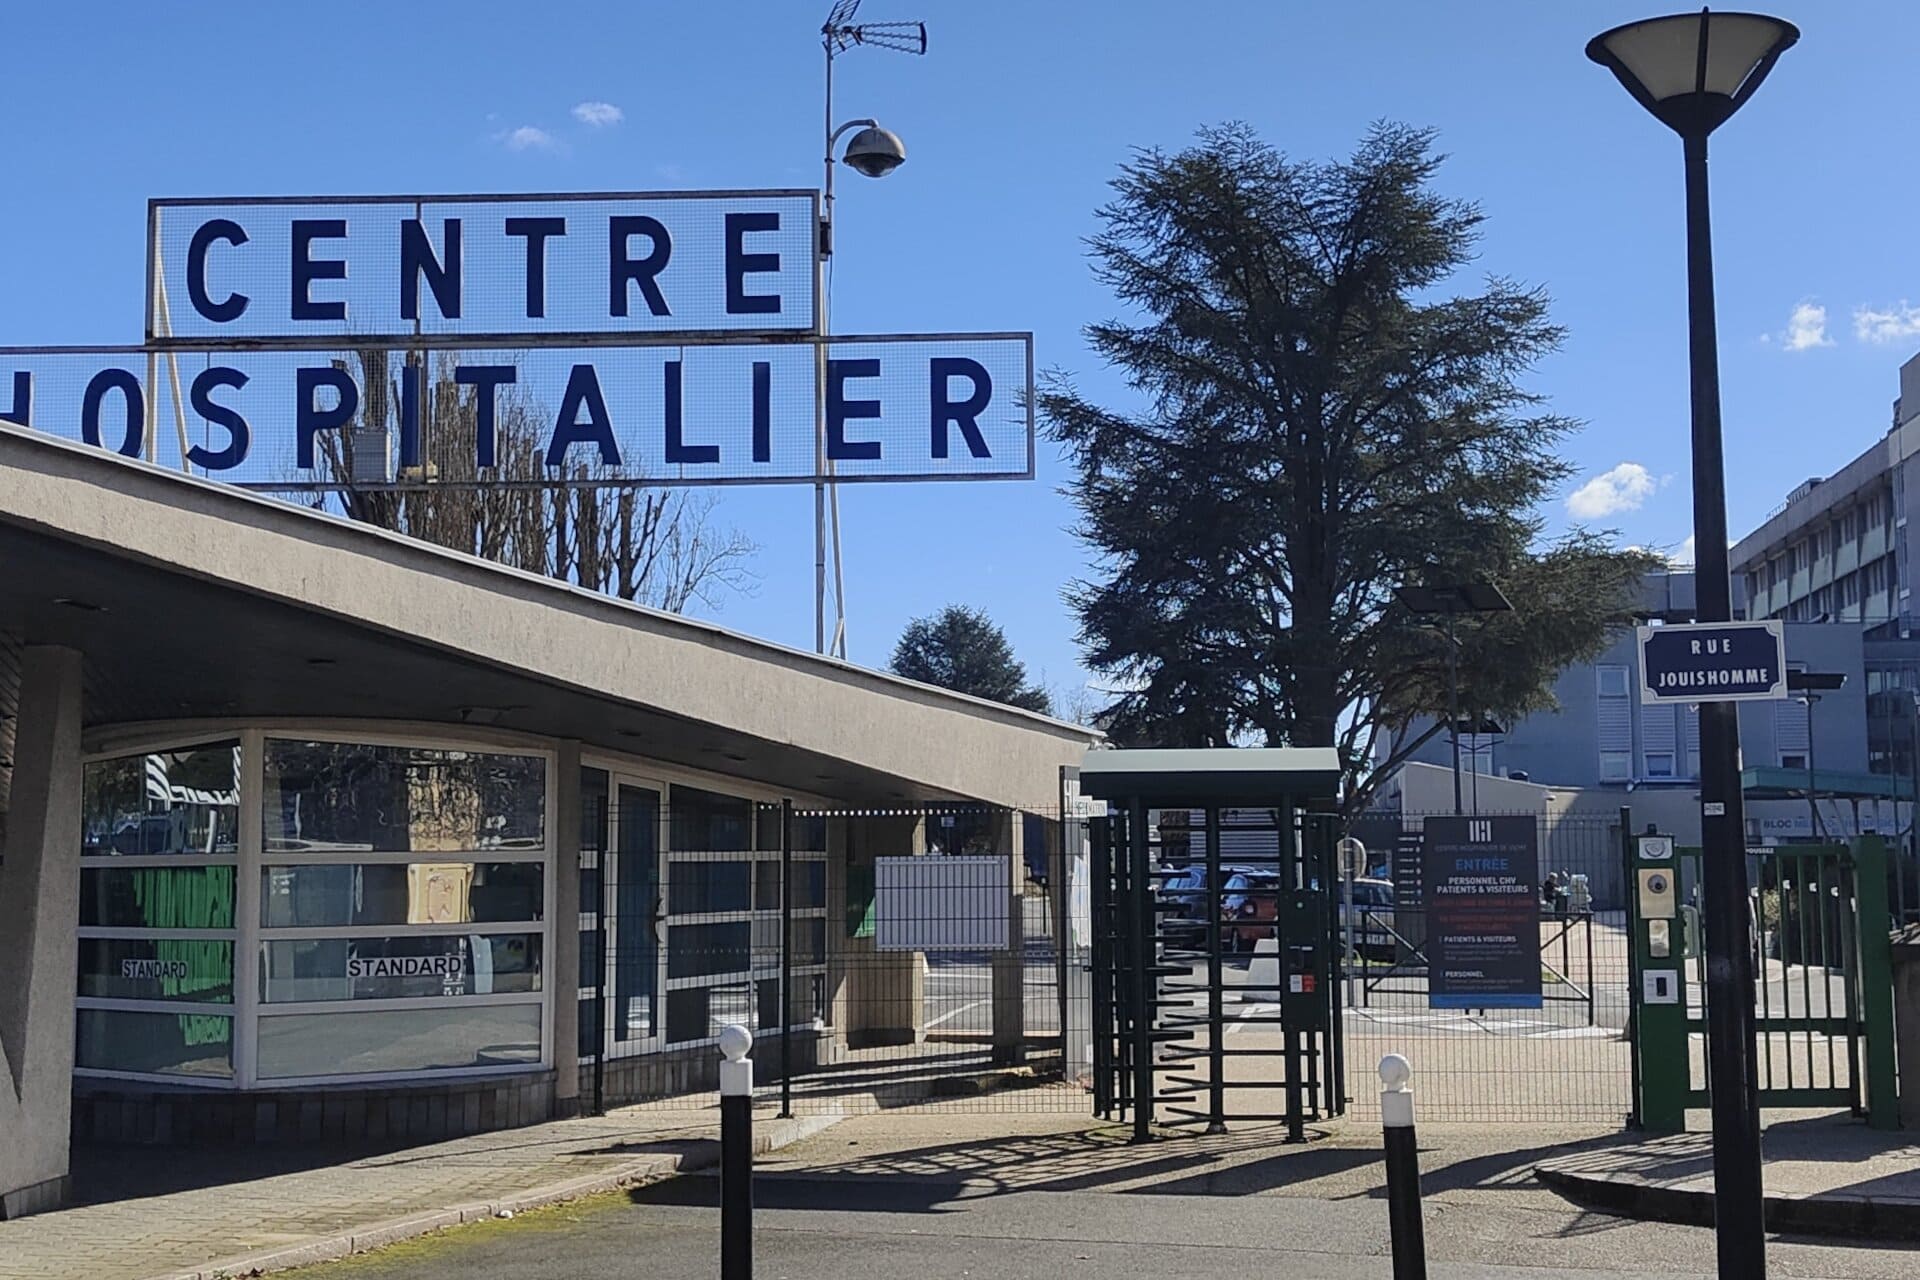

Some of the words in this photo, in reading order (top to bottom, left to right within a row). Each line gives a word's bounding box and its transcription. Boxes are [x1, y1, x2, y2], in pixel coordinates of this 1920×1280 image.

[187, 213, 782, 324] CENTRE
[1691, 639, 1731, 654] RUE
[1659, 669, 1768, 687] JOUISHOMME
[1448, 876, 1498, 885] PERSONNEL
[1436, 885, 1477, 894] PATIENTS
[1478, 885, 1485, 893] &
[1486, 885, 1529, 893] VISITEURS
[1444, 935, 1476, 943] PATIENTS
[1483, 935, 1517, 943] VISITEURS
[123, 961, 187, 979] STANDARD
[349, 957, 461, 977] STANDARD
[1445, 970, 1485, 978] PERSONNEL
